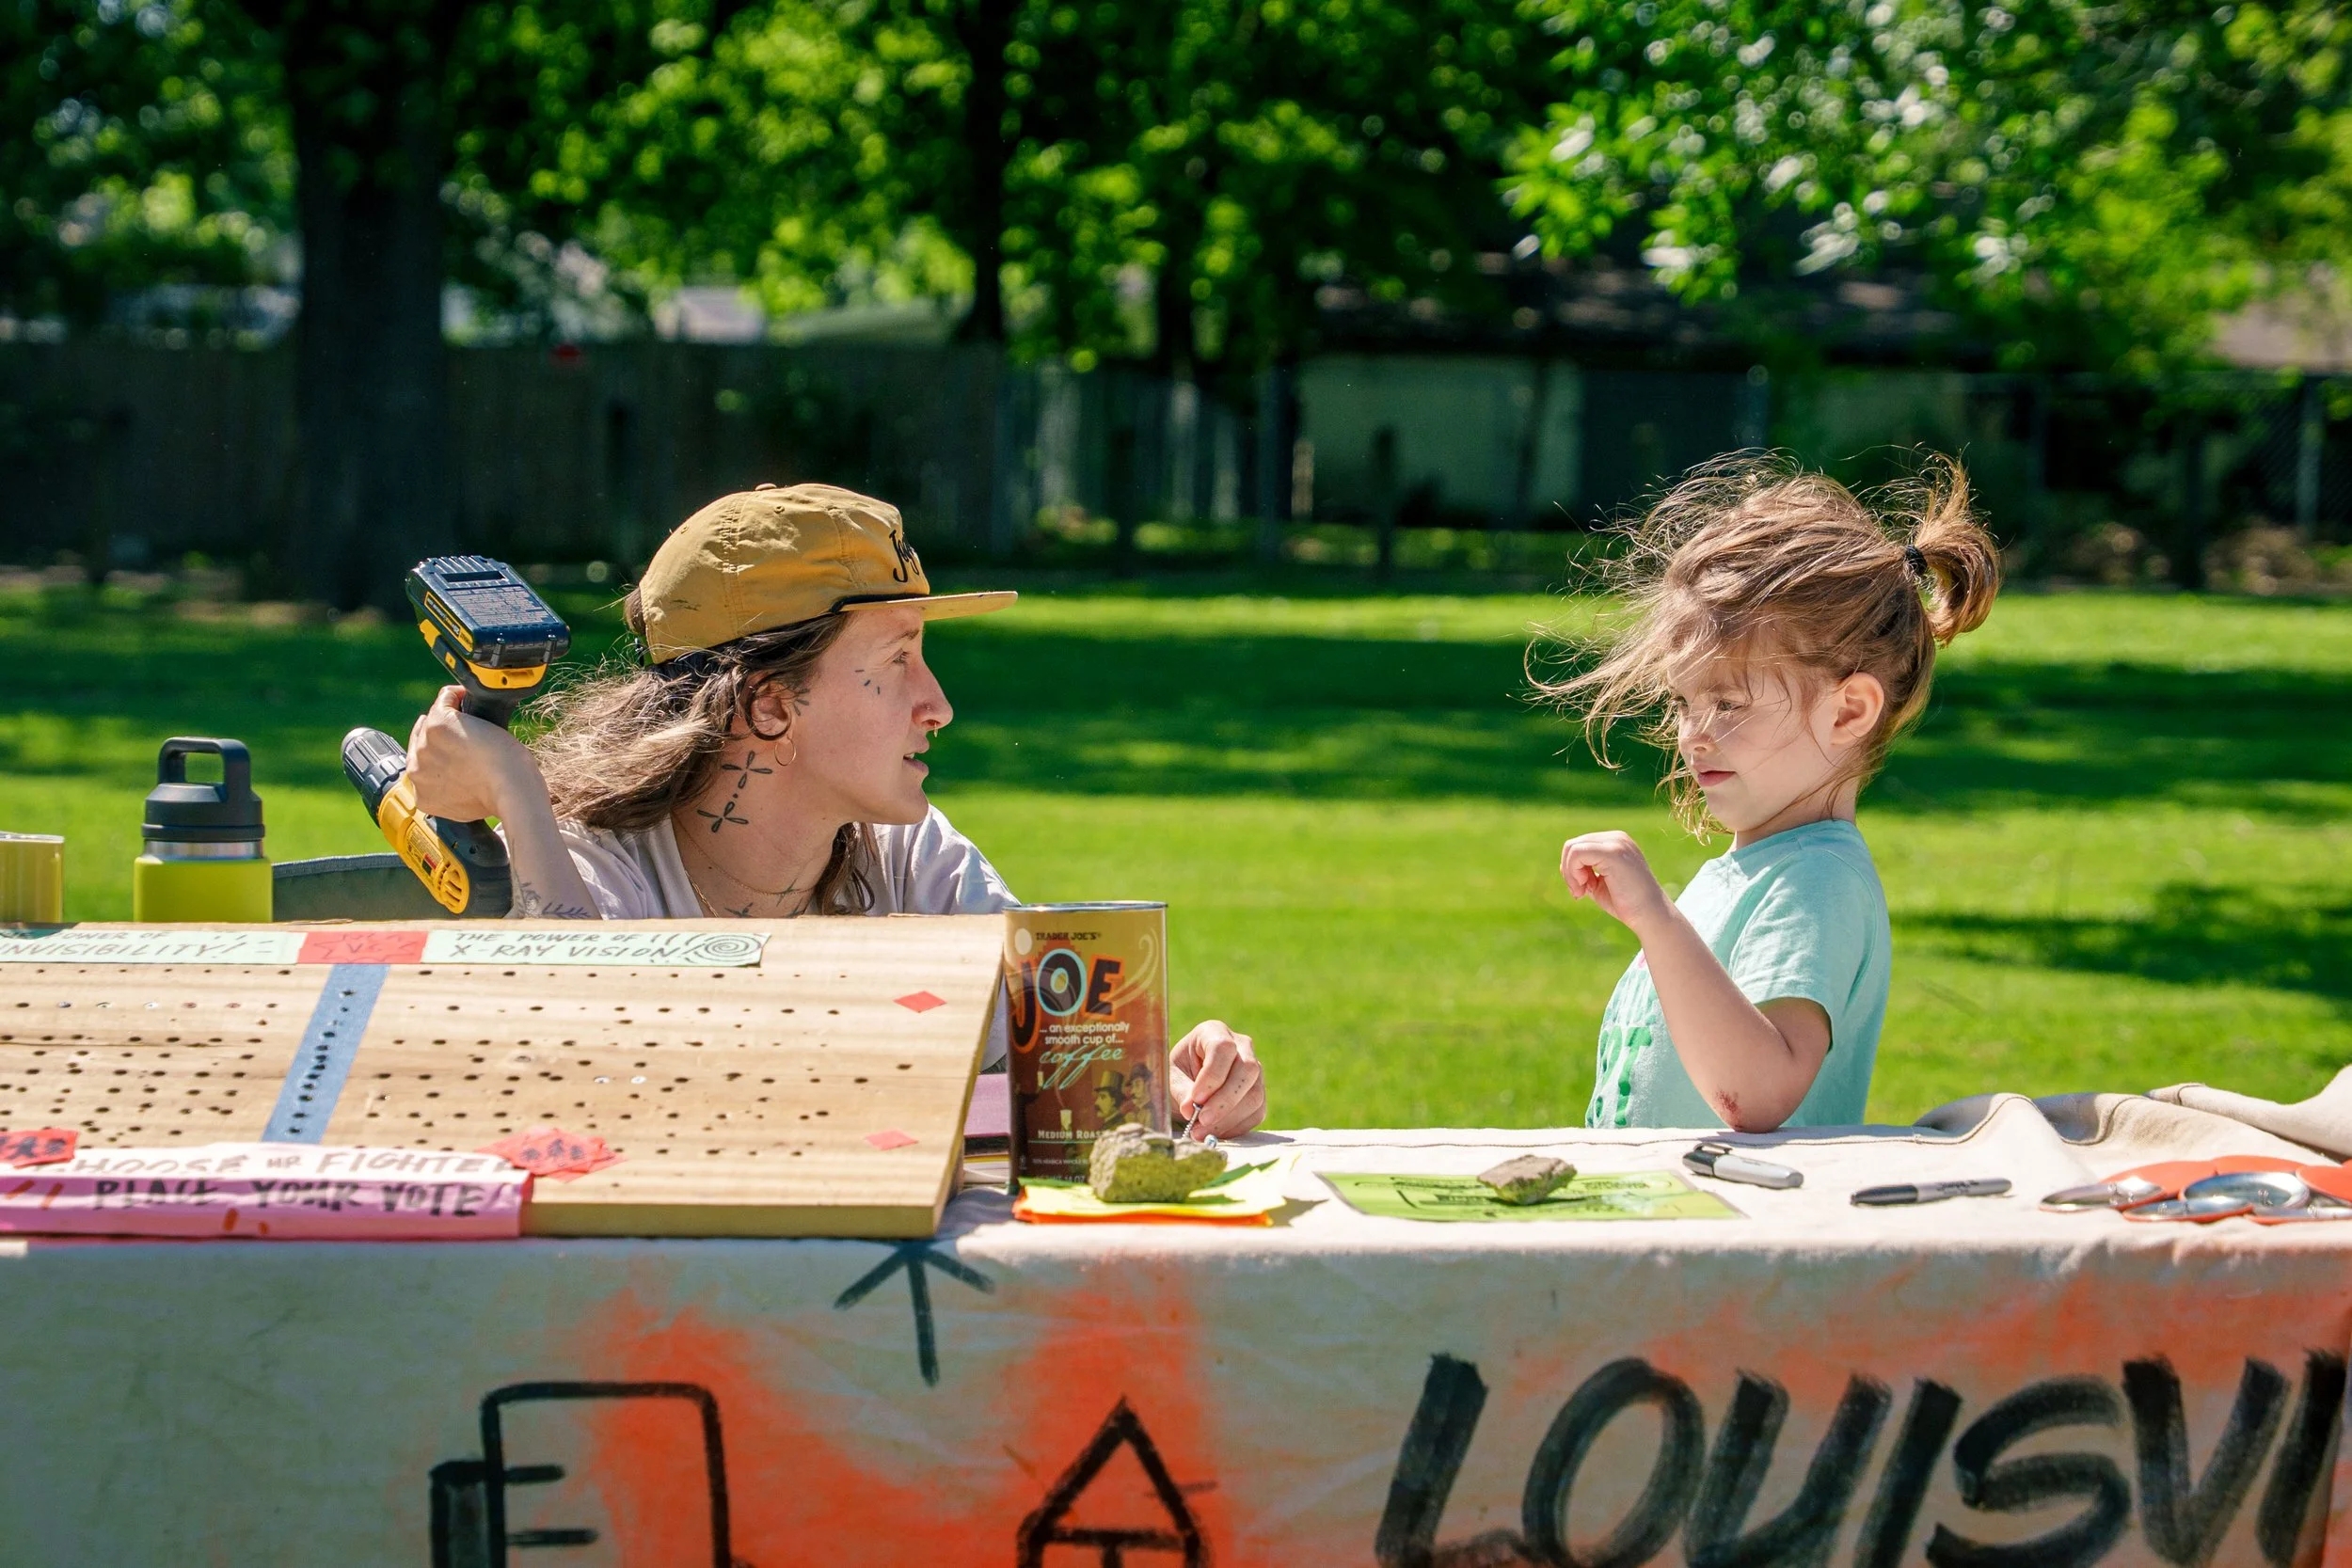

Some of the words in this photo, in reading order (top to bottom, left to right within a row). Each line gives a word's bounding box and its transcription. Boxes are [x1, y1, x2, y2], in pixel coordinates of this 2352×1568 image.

[455, 933, 504, 942] THE
[517, 932, 600, 942] POWER
[612, 933, 641, 942] OF
[1036, 932, 1069, 941] TRADER
[1010, 948, 1125, 1053] JOE
[1049, 1024, 1063, 1034] an
[1064, 1022, 1130, 1036] exceptionally
[1044, 1035, 1081, 1046] smooth
[1082, 1036, 1104, 1047] cup
[1039, 1044, 1124, 1090] coffee
